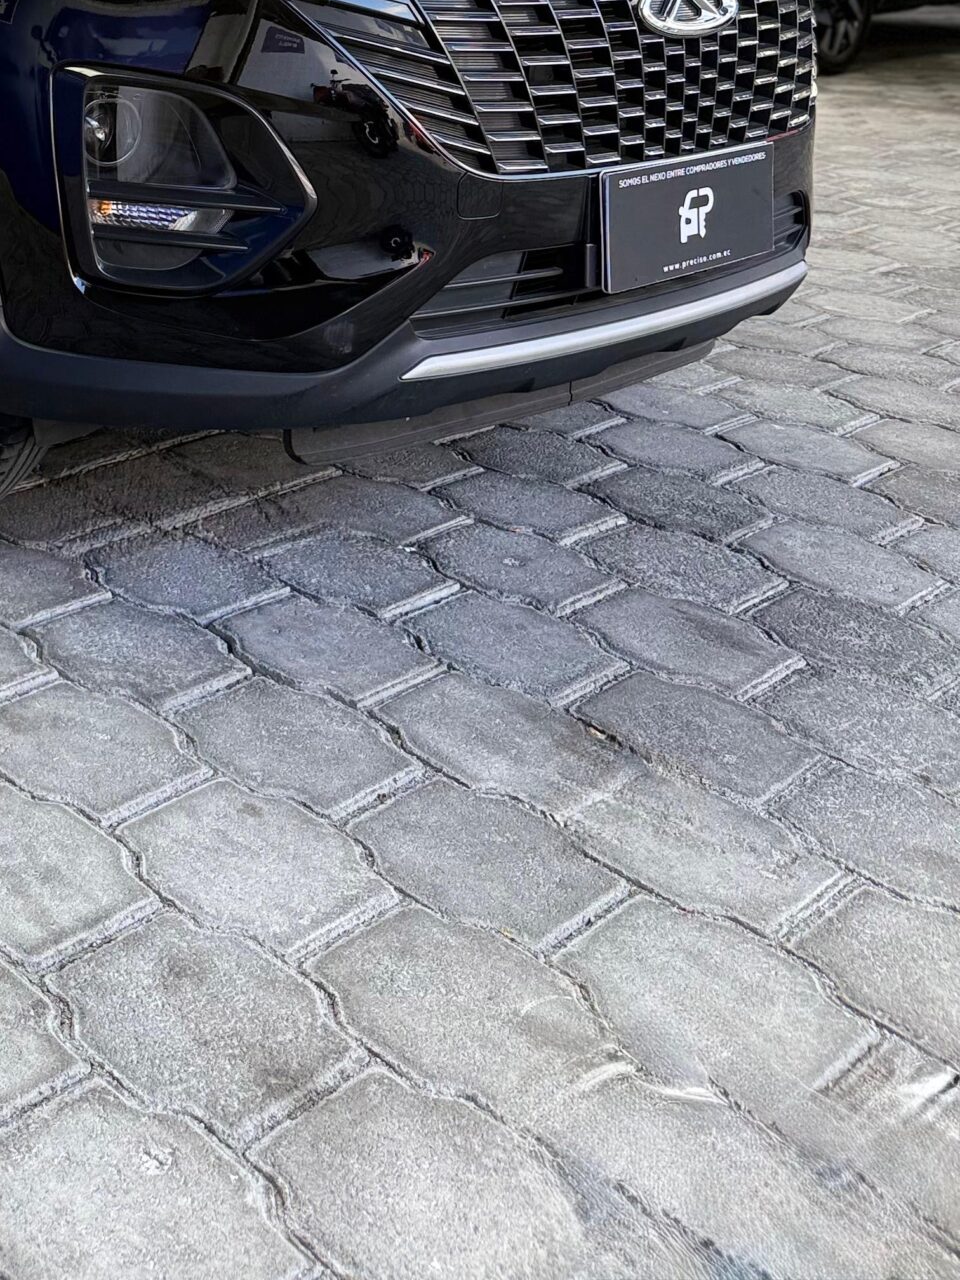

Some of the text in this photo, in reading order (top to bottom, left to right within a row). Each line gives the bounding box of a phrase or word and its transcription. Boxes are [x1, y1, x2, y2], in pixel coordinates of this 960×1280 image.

[618, 176, 641, 189] SOMOS
[642, 174, 649, 184] EL
[650, 171, 666, 182] NEXO
[666, 167, 685, 179] ENTRE
[686, 159, 728, 175] COMPRADORES
[731, 151, 767, 166] VENDEDORES
